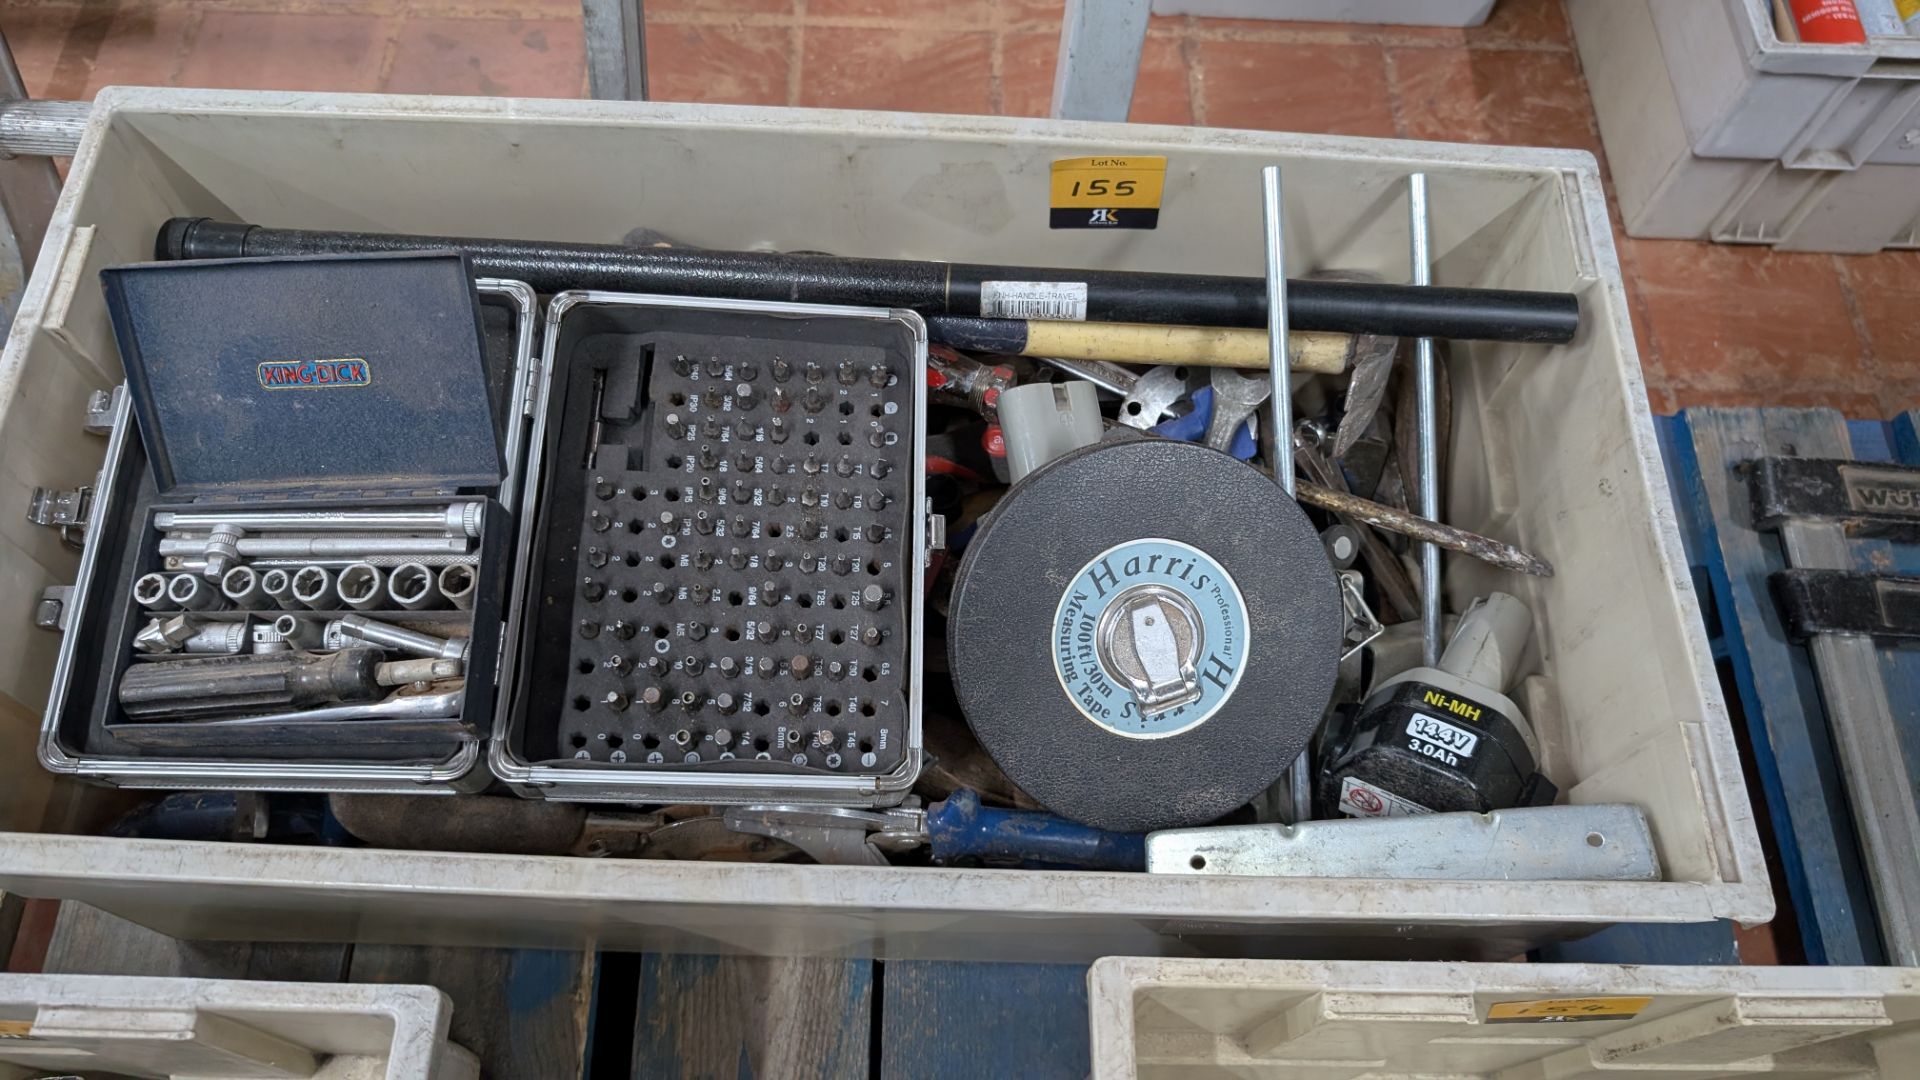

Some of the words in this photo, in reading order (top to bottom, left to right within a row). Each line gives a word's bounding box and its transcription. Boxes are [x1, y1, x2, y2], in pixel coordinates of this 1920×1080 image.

[1071, 179, 1138, 197] 155
[724, 364, 733, 381] 5/64
[689, 394, 699, 413] IP30
[723, 394, 733, 412] 3/32
[687, 424, 696, 441] IP25
[721, 425, 730, 442] 7/64
[686, 455, 695, 473] IP20
[719, 460, 728, 473] 1/8
[755, 456, 763, 473] 5/64
[820, 463, 829, 473] T7
[854, 464, 863, 475] T7
[754, 488, 763, 506] 3/32
[716, 519, 725, 537] 5/32
[751, 521, 760, 539] 7/64
[749, 554, 759, 568] 1/8
[818, 555, 827, 572] T20
[851, 556, 861, 573] T20
[1088, 553, 1211, 600] Harris
[678, 587, 688, 600] M6
[816, 588, 826, 606] T25
[851, 589, 860, 606] T25
[746, 621, 756, 641] 5/32
[815, 623, 824, 641] T27
[849, 624, 859, 641] T27
[1060, 589, 1089, 685] Measuring
[1077, 684, 1112, 720] Tape
[1077, 611, 1114, 699] 100ft/30m
[674, 661, 683, 670] 10
[814, 658, 823, 676] T30
[848, 659, 858, 677] T30
[742, 691, 752, 713] 7/32
[812, 695, 822, 713] T35
[848, 695, 858, 713] T40
[1423, 690, 1482, 722] Ni-MH
[741, 731, 751, 746] 1/4
[777, 726, 787, 749] 8mm
[846, 730, 856, 749] T45
[879, 728, 889, 750] 8mm
[1414, 718, 1472, 751] 14.4V
[1408, 738, 1459, 767] 3.0Ah
